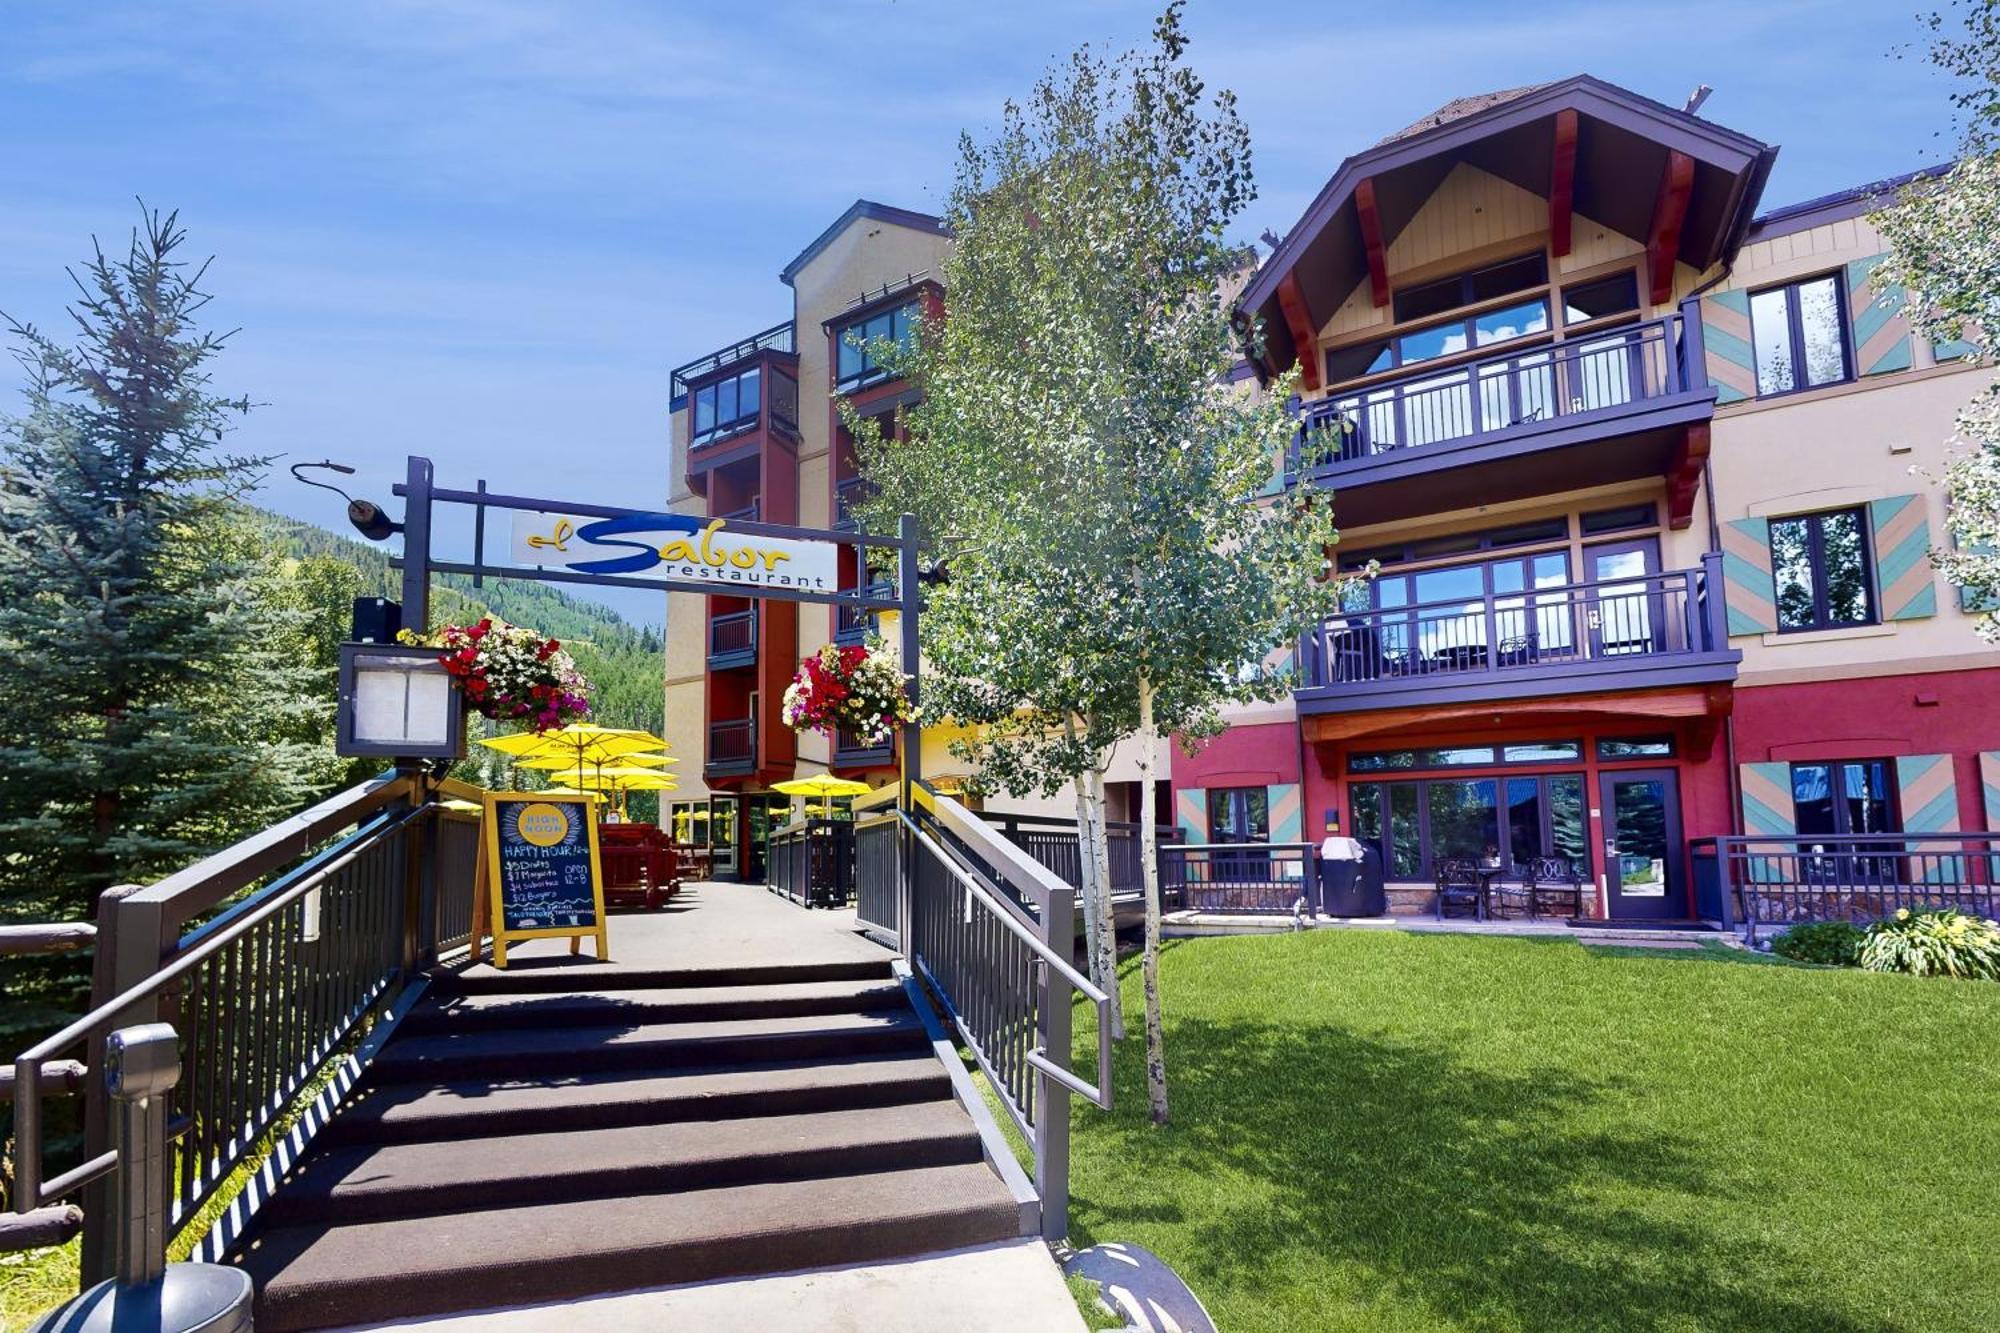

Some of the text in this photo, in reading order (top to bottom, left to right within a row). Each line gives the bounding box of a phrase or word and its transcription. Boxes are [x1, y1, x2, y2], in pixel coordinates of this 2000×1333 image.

[528, 513, 791, 575] el Sabor
[666, 562, 824, 589] restaurant
[504, 845, 538, 858] HAPPY
